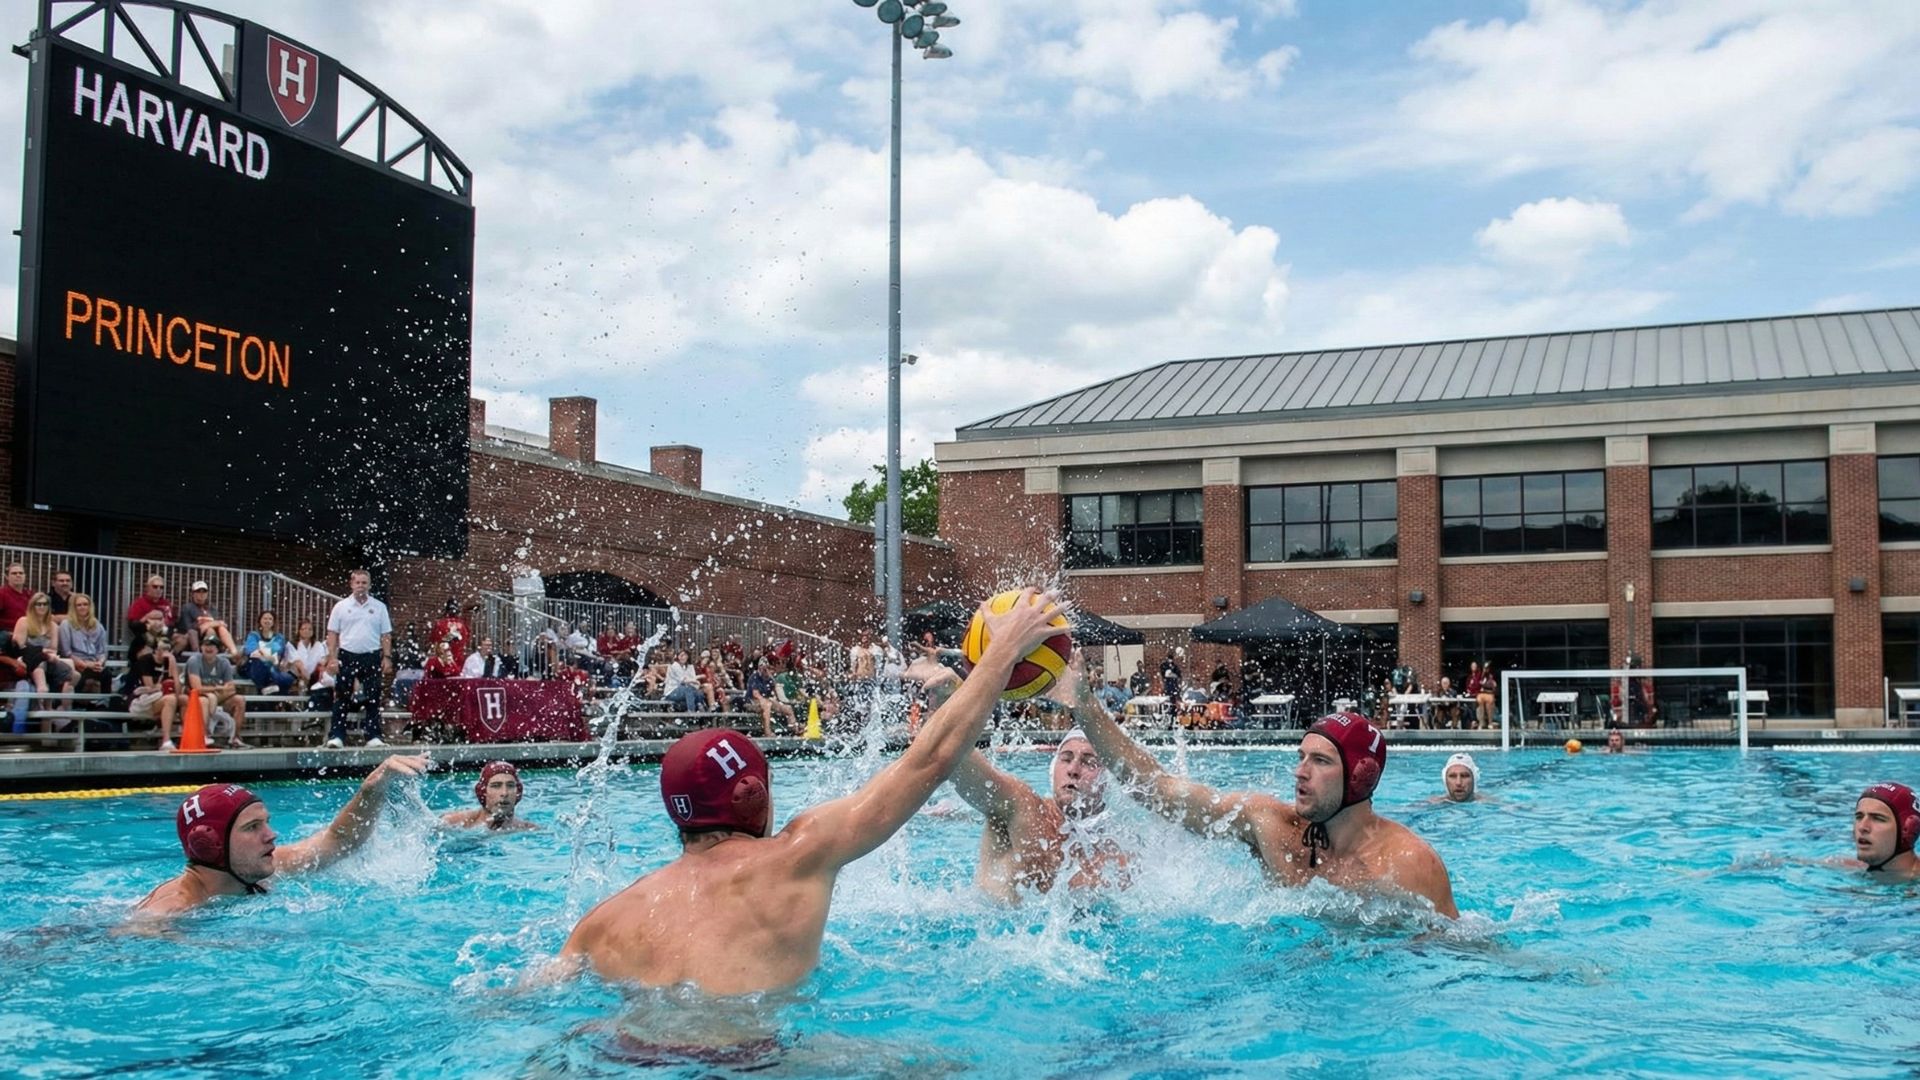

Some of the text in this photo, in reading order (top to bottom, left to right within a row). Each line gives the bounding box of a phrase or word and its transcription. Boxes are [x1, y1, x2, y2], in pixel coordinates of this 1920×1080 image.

[279, 49, 306, 104] H
[73, 66, 270, 180] HARVARD
[65, 290, 290, 388] PRINCETON
[484, 693, 502, 719] H
[706, 739, 747, 779] H
[182, 795, 205, 825] H
[674, 798, 688, 814] H
